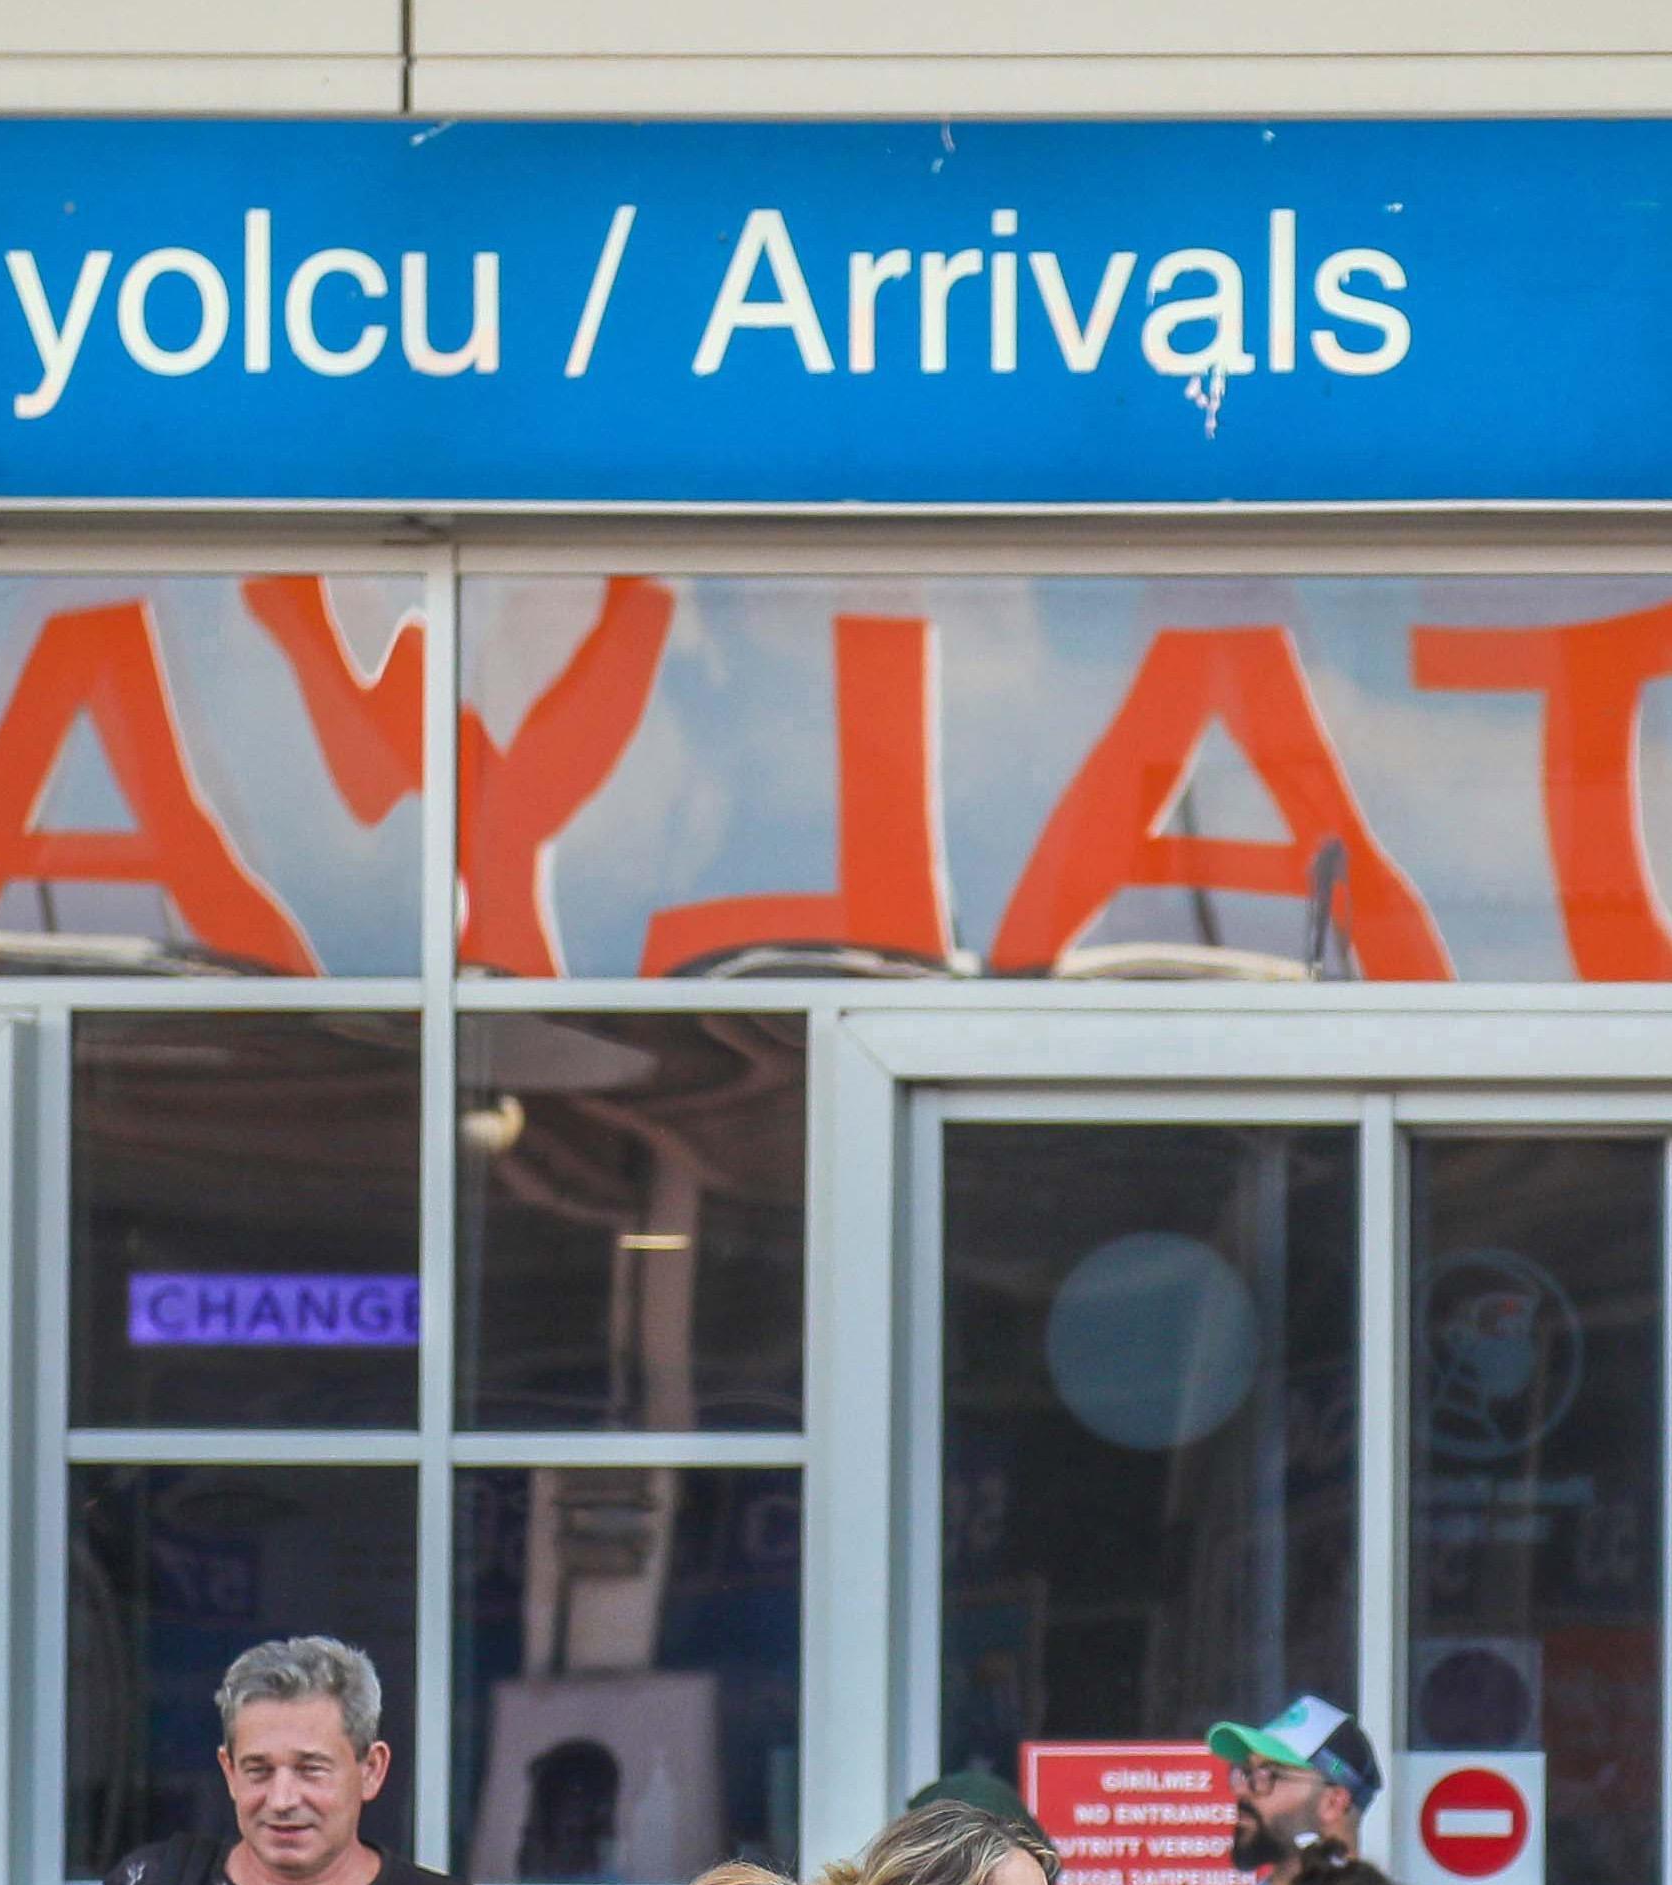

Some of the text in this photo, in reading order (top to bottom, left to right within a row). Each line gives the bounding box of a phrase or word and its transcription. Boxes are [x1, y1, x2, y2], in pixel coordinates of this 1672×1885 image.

[5, 206, 500, 420] yolcu
[565, 204, 637, 378] /
[691, 207, 1412, 377] Arrivals
